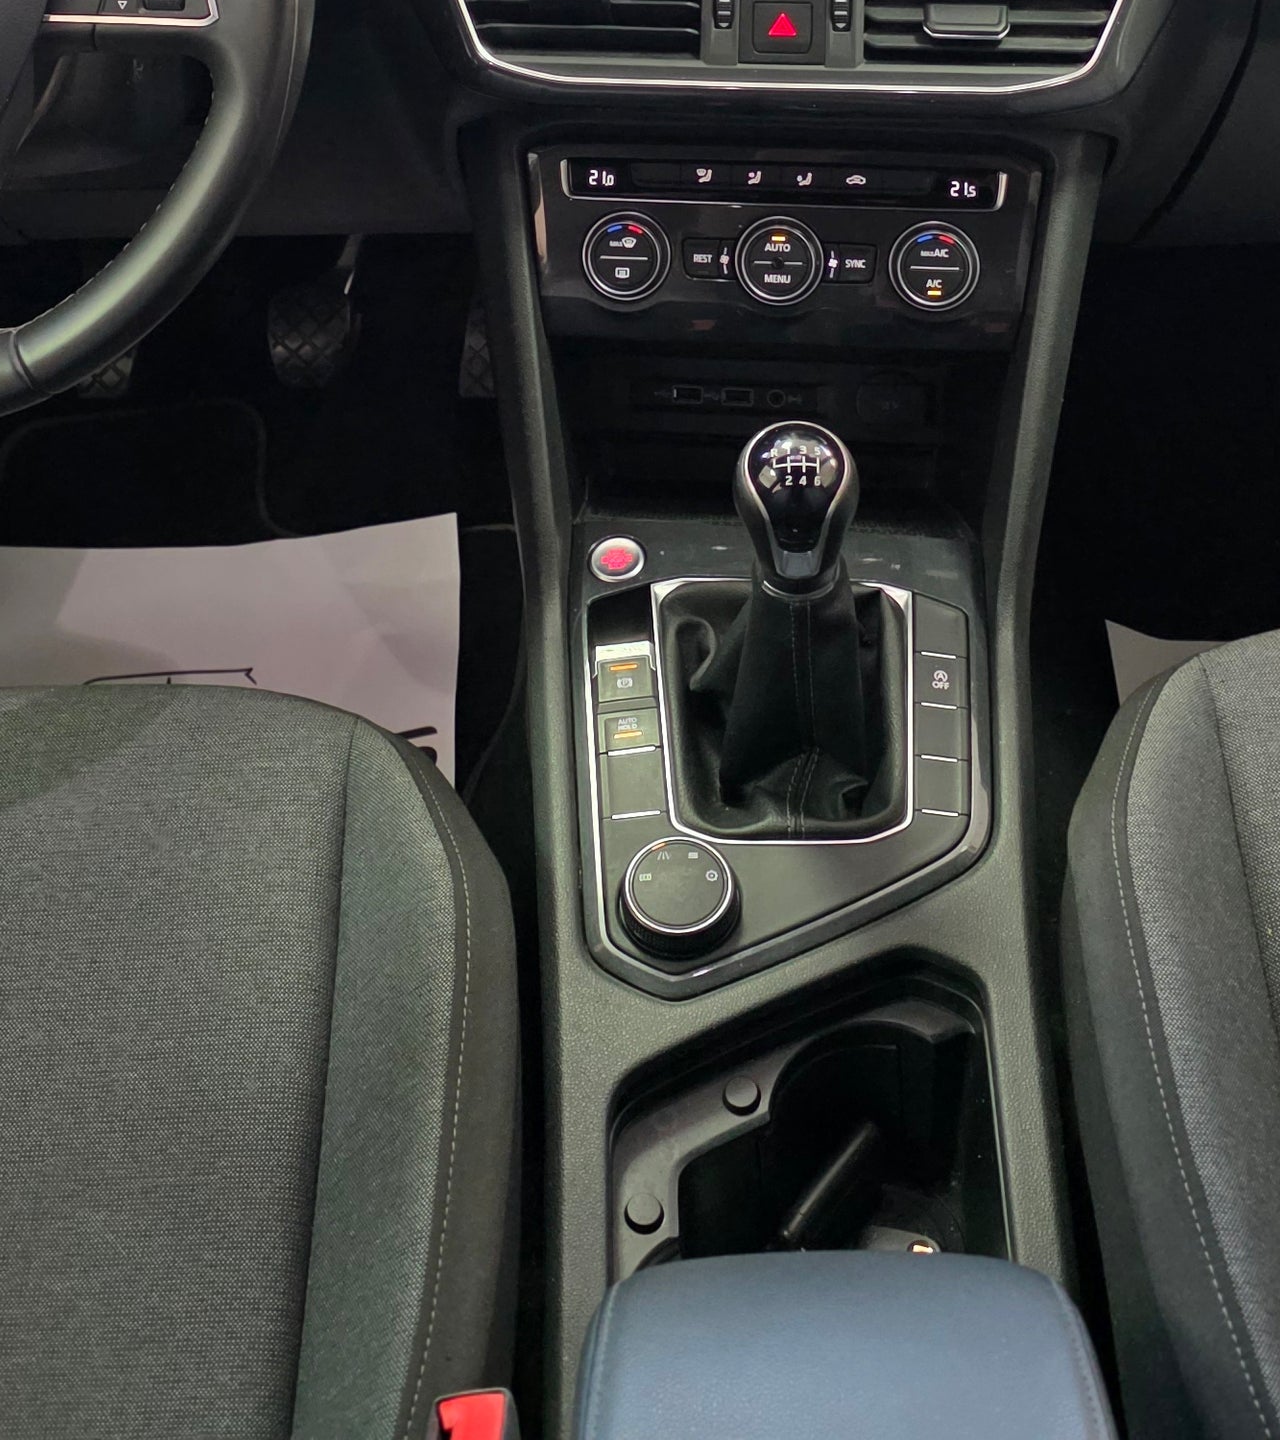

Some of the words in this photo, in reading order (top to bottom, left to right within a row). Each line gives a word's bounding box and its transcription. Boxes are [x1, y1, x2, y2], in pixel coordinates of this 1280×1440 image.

[764, 243, 791, 252] AUTO
[693, 253, 712, 263] REST
[845, 259, 866, 269] SYNC
[764, 274, 791, 284] MENU
[926, 279, 942, 288] A/C
[770, 448, 778, 457] R
[800, 445, 807, 455] 3
[814, 447, 821, 456] 5
[785, 475, 793, 486] 2
[799, 475, 807, 486] 4
[814, 475, 821, 487] 6
[932, 681, 950, 690] OFF
[618, 717, 637, 725] AUTO
